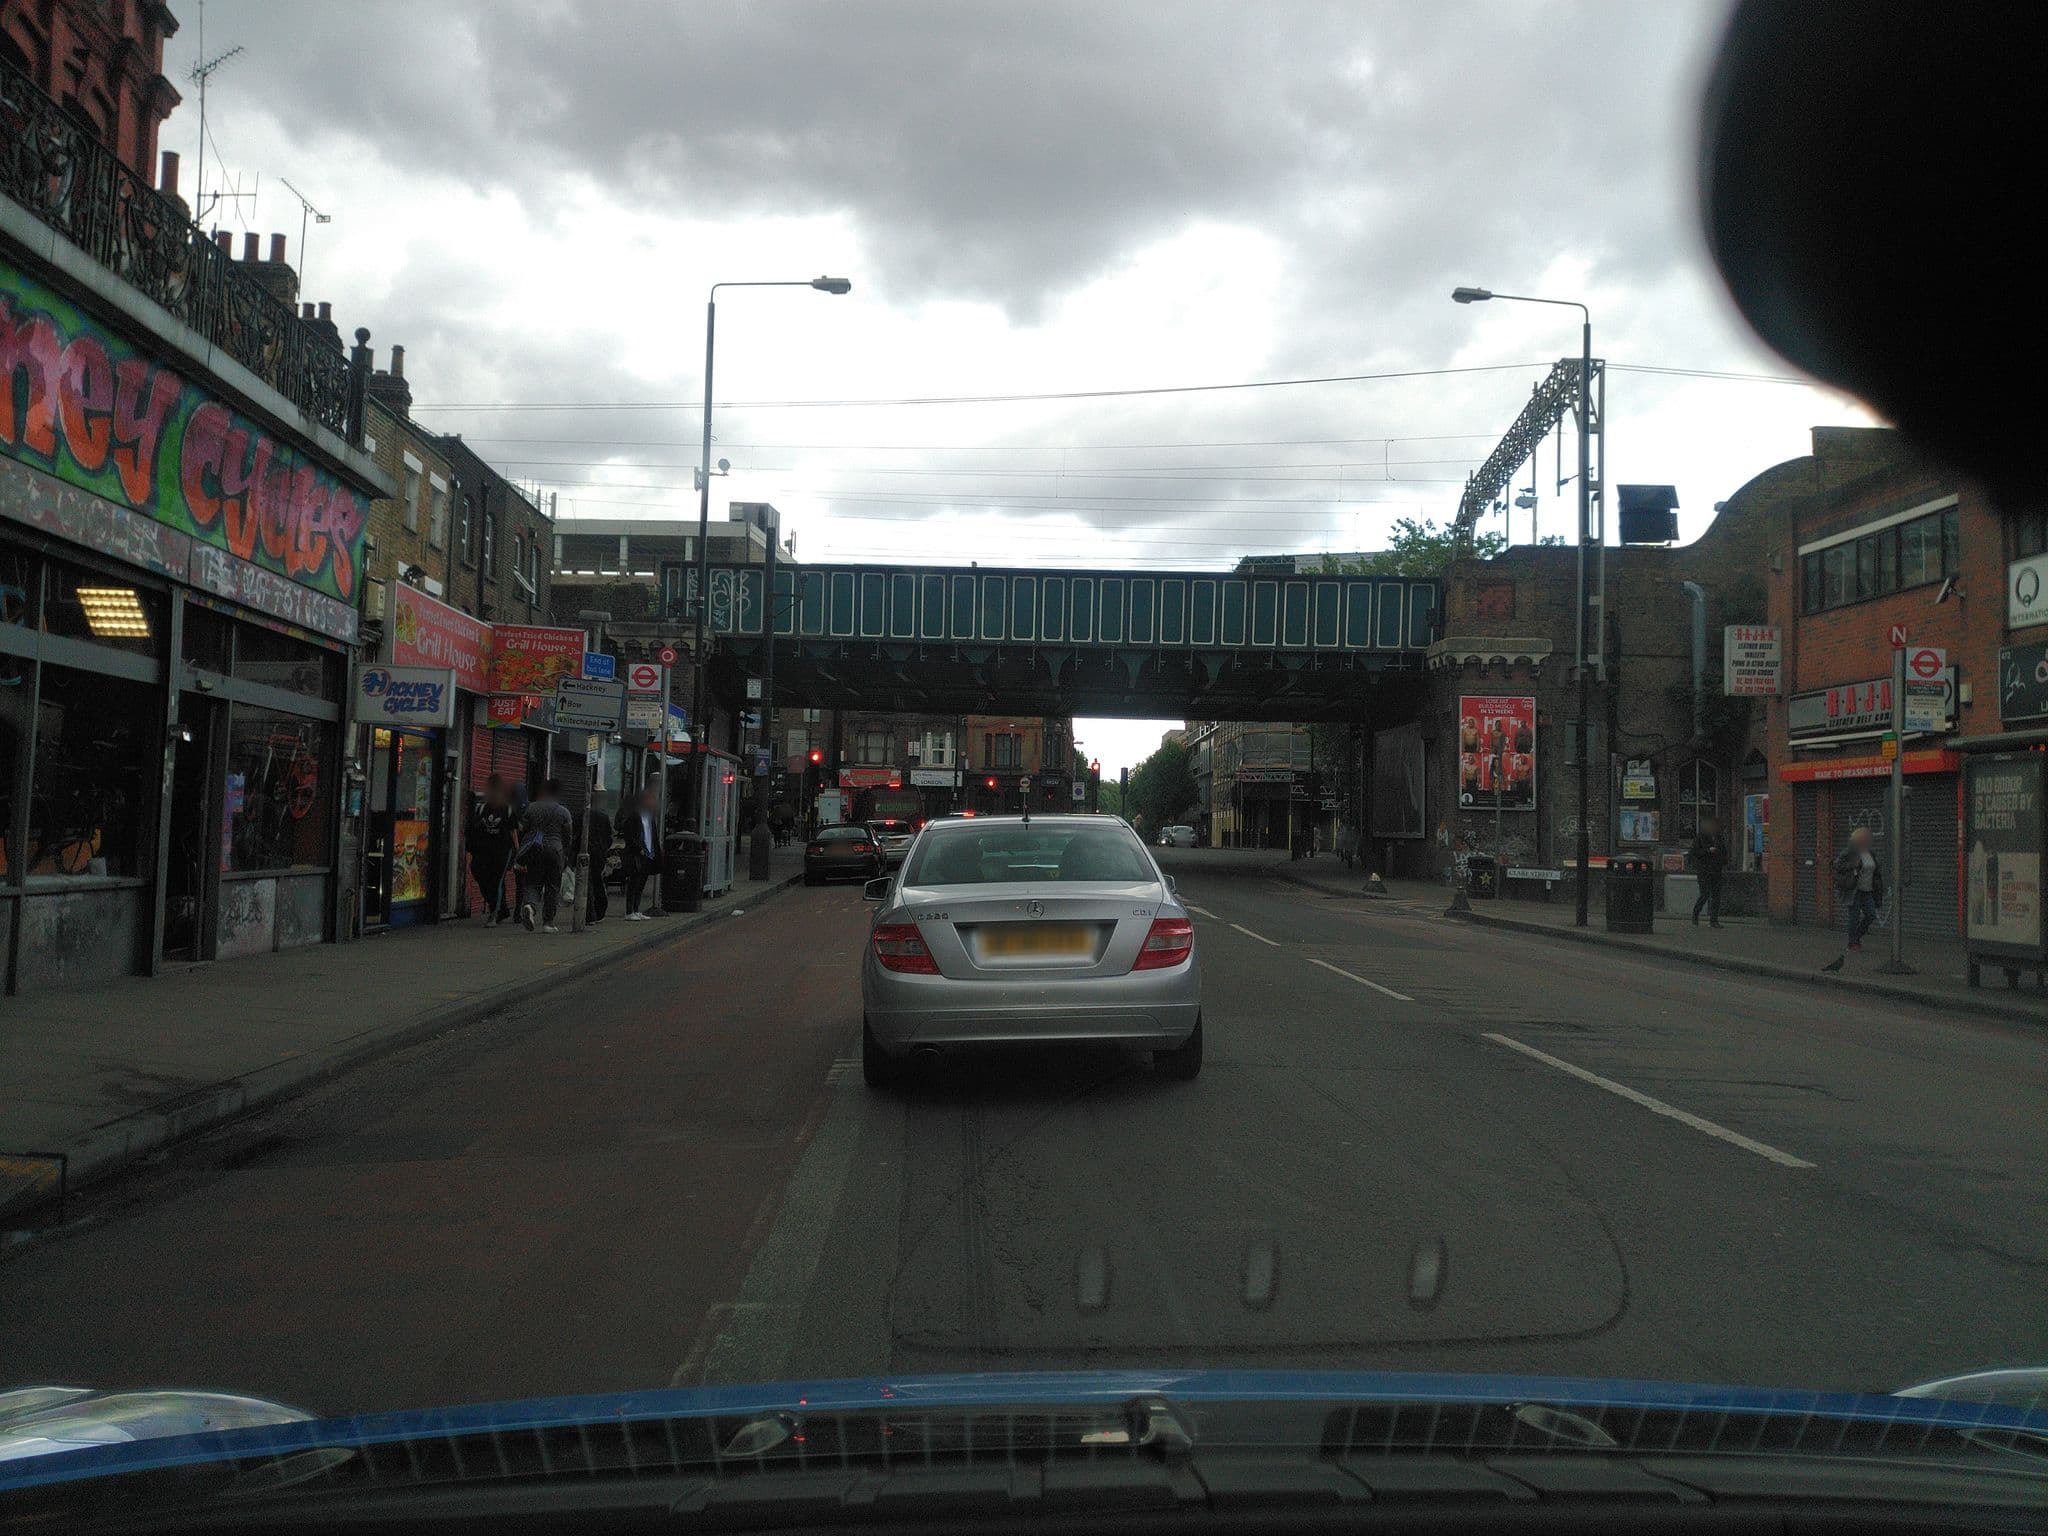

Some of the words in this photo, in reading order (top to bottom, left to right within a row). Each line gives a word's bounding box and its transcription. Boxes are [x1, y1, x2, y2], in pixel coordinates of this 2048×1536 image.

[1892, 626, 1906, 643] N
[416, 626, 442, 660] Grill
[444, 636, 478, 673] House
[505, 638, 530, 650] Grill
[531, 640, 567, 652] House
[576, 682, 606, 693] Hackney
[383, 697, 441, 714] CYCLES
[492, 699, 516, 708] JUST
[567, 700, 582, 708] Bow
[496, 707, 516, 716] EAT
[557, 715, 600, 727] Whitechapel
[1829, 717, 1854, 728] LEATHER
[1856, 714, 1872, 724] BELT
[1874, 712, 1892, 722] COM
